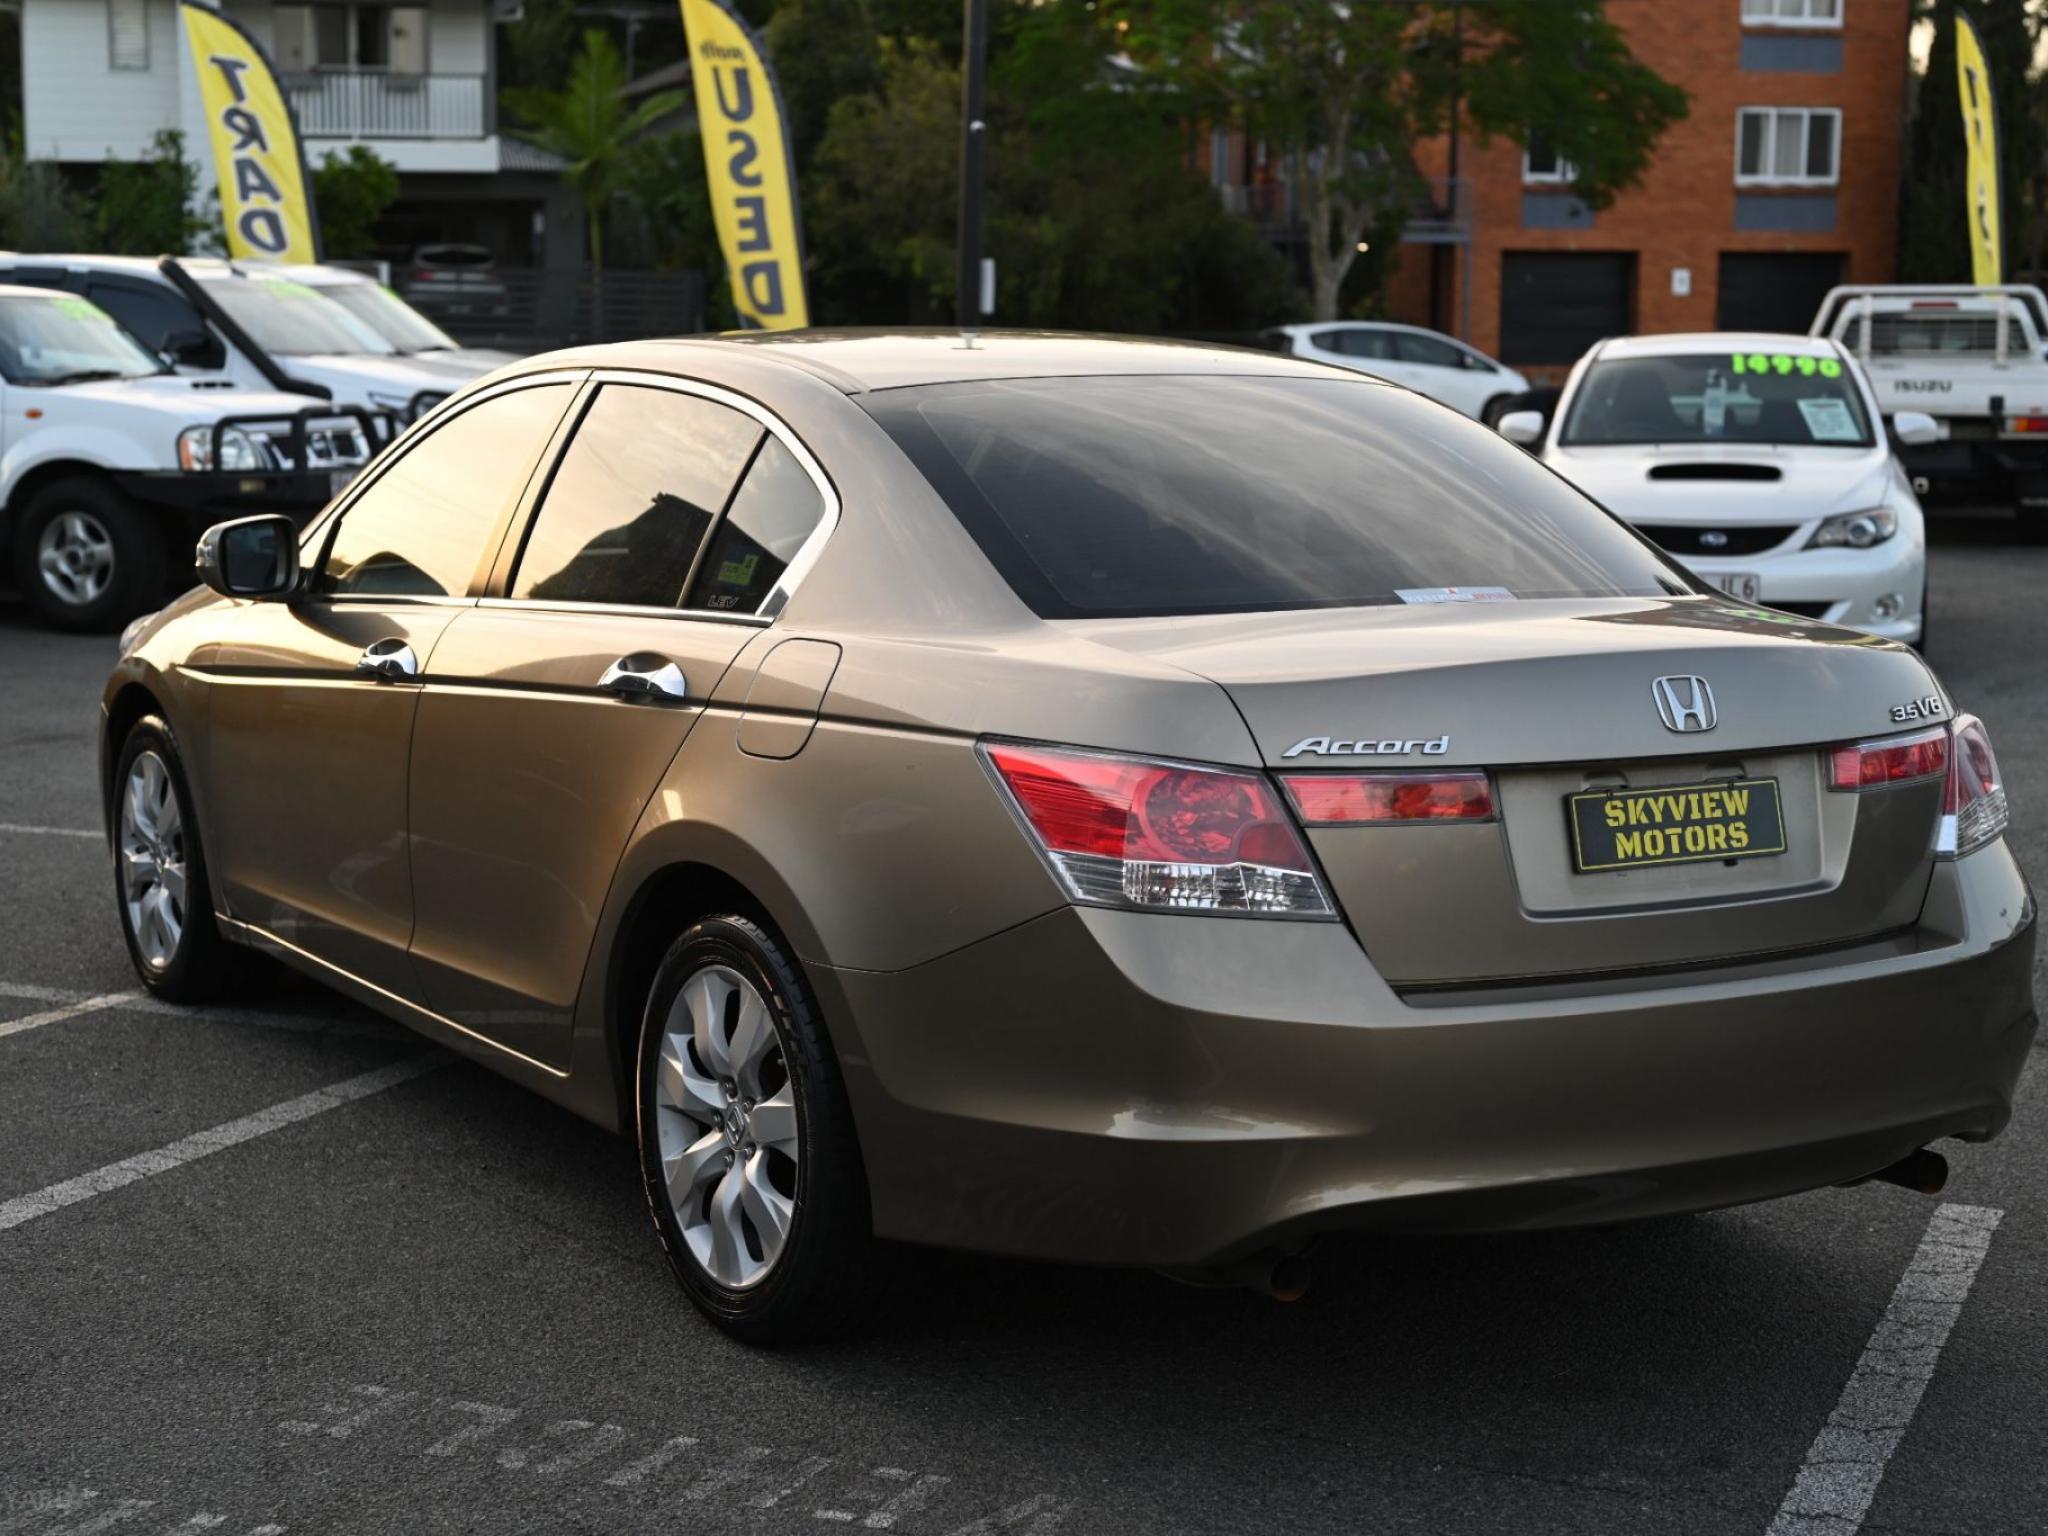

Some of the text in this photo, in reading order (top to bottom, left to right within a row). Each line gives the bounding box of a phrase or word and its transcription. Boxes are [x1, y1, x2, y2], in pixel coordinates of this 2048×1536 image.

[1894, 380, 1952, 393] ISUZU
[1282, 735, 1449, 758] Accord
[1604, 790, 1749, 827] SKYVIEW
[1616, 821, 1749, 859] MOTORS
